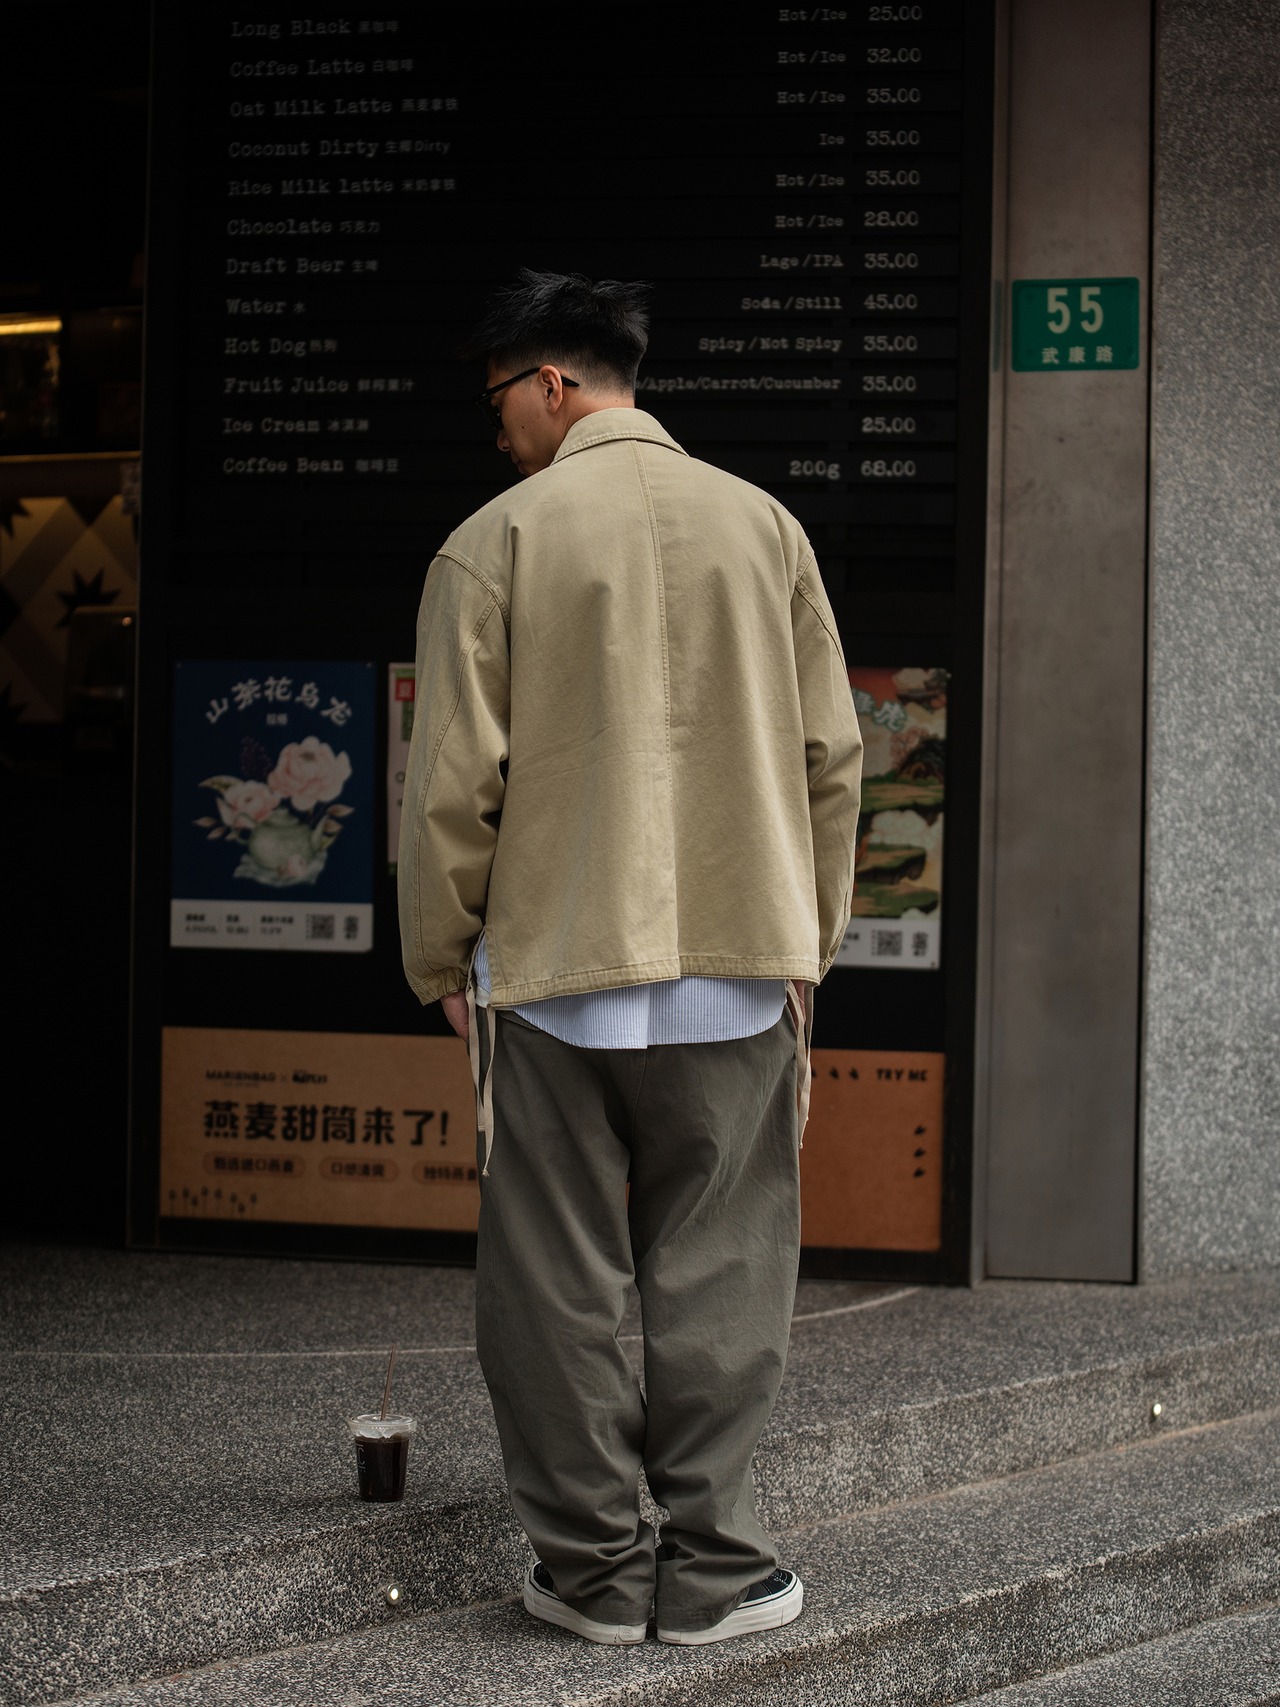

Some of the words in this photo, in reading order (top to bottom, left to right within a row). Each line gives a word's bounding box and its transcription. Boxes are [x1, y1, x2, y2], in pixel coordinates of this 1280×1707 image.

[779, 9, 846, 21] Hot/Ice
[869, 6, 922, 21] 25.00
[231, 22, 280, 39] Long
[291, 19, 350, 35] Black
[778, 51, 845, 63] Hot/Ice
[867, 48, 921, 63] 32.00
[231, 61, 298, 77] Coffee
[307, 59, 365, 75] Latte
[777, 91, 845, 103] Hot/Ice
[867, 88, 920, 103] 35.00
[231, 102, 264, 117] Oat
[275, 100, 325, 116] Milk
[335, 99, 392, 114] Latte
[819, 134, 844, 145] Ice
[867, 130, 920, 146] 35.00
[229, 141, 310, 157] Coconut
[320, 140, 378, 158] Dirty
[776, 174, 844, 186] Hot/Ice
[866, 170, 919, 185] 35.00
[228, 180, 272, 195] Rice
[281, 179, 330, 195] Milk
[339, 179, 393, 193] latte
[227, 219, 332, 235] Chocolate
[775, 215, 843, 228] Hot/Ice
[864, 211, 918, 226] 28.00
[227, 258, 286, 274] Draft
[296, 258, 344, 273] Beer
[865, 253, 918, 268] 35.00
[226, 299, 286, 314] Water
[864, 294, 917, 309] 45.00
[1047, 286, 1104, 334] 55
[225, 338, 259, 354] Hot
[270, 338, 306, 357] Dog
[796, 337, 842, 352] Spicy
[864, 336, 917, 351] 35.00
[1041, 346, 1114, 364] 武康路
[224, 377, 282, 393] Fruit
[291, 377, 349, 393] Juice
[863, 376, 916, 392] 35.00
[223, 418, 253, 433] Ice
[261, 418, 320, 433] Cream
[862, 417, 915, 433] 25.00
[224, 457, 288, 473] Coffee
[297, 458, 344, 472] Bean
[790, 460, 840, 480] 200g
[861, 460, 915, 476] 68.00
[204, 675, 353, 727] 山茶花乌龙
[876, 1069, 904, 1081] TRY
[909, 1069, 928, 1082] ME
[204, 1101, 449, 1146] 燕麦甜筒来了!
